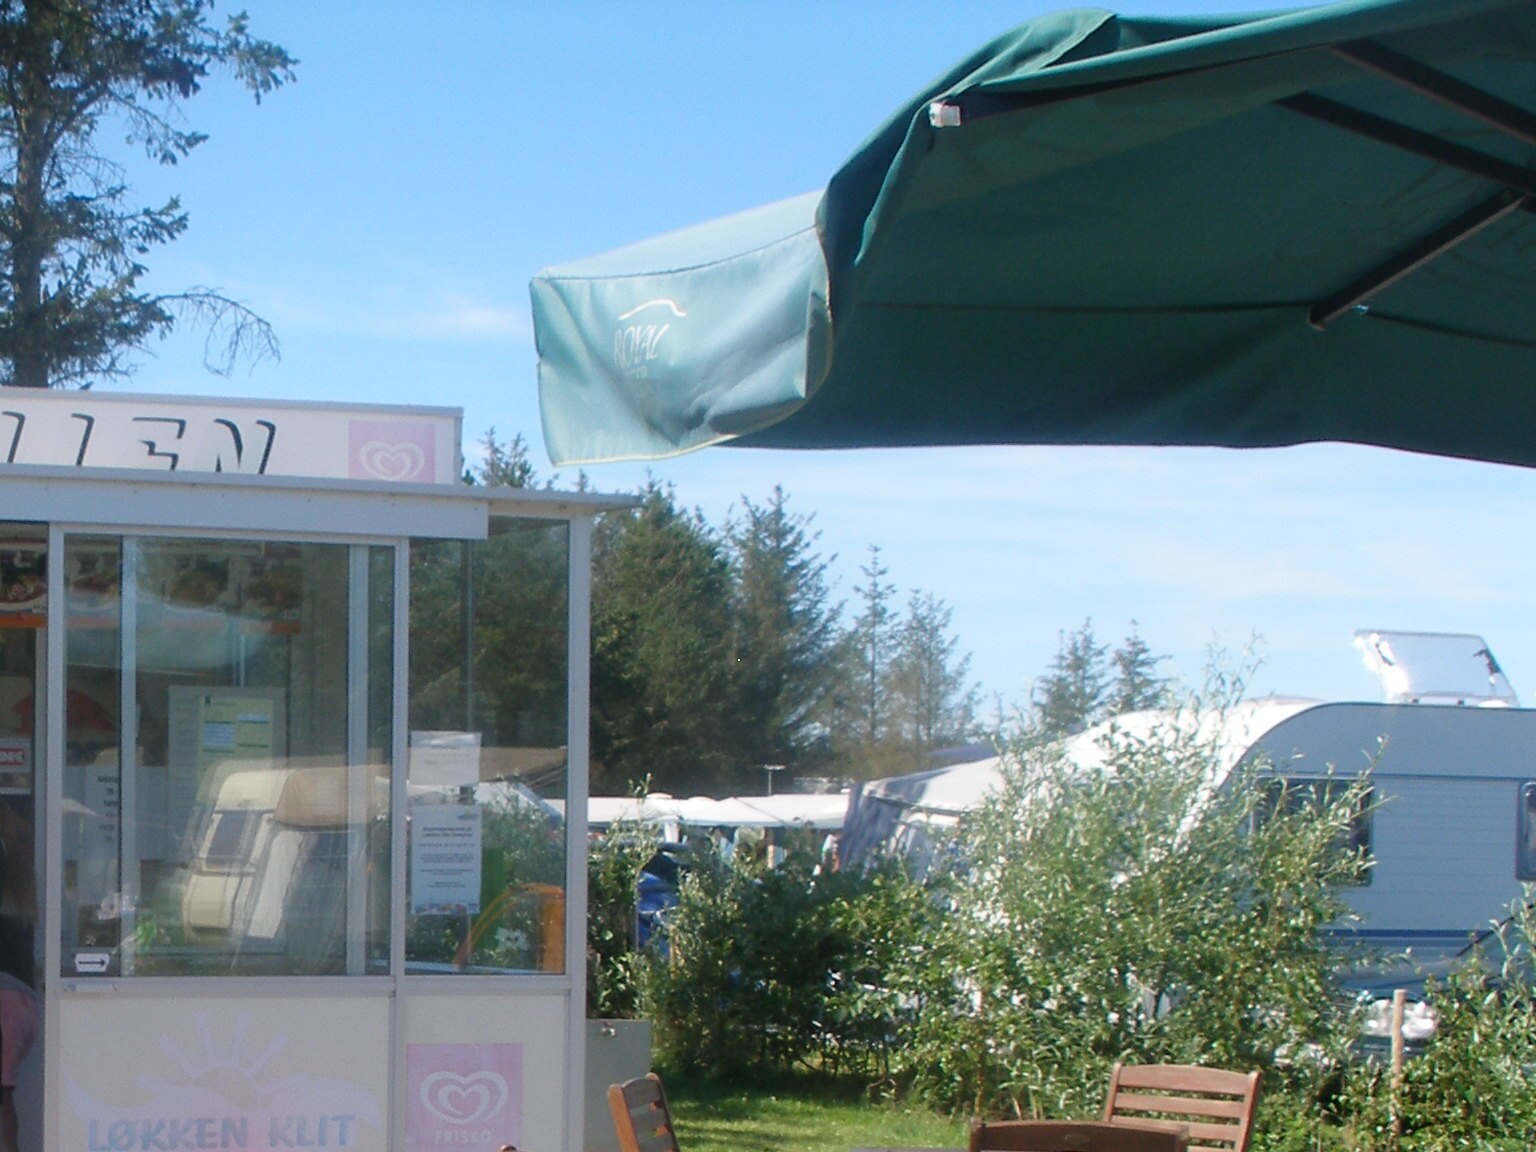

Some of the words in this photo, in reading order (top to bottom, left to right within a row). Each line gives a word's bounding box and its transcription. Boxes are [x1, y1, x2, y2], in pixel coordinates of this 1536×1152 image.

[87, 1117, 250, 1152] LØKKEN
[267, 1113, 356, 1148] KLIT
[434, 1129, 493, 1144] FRISKO
